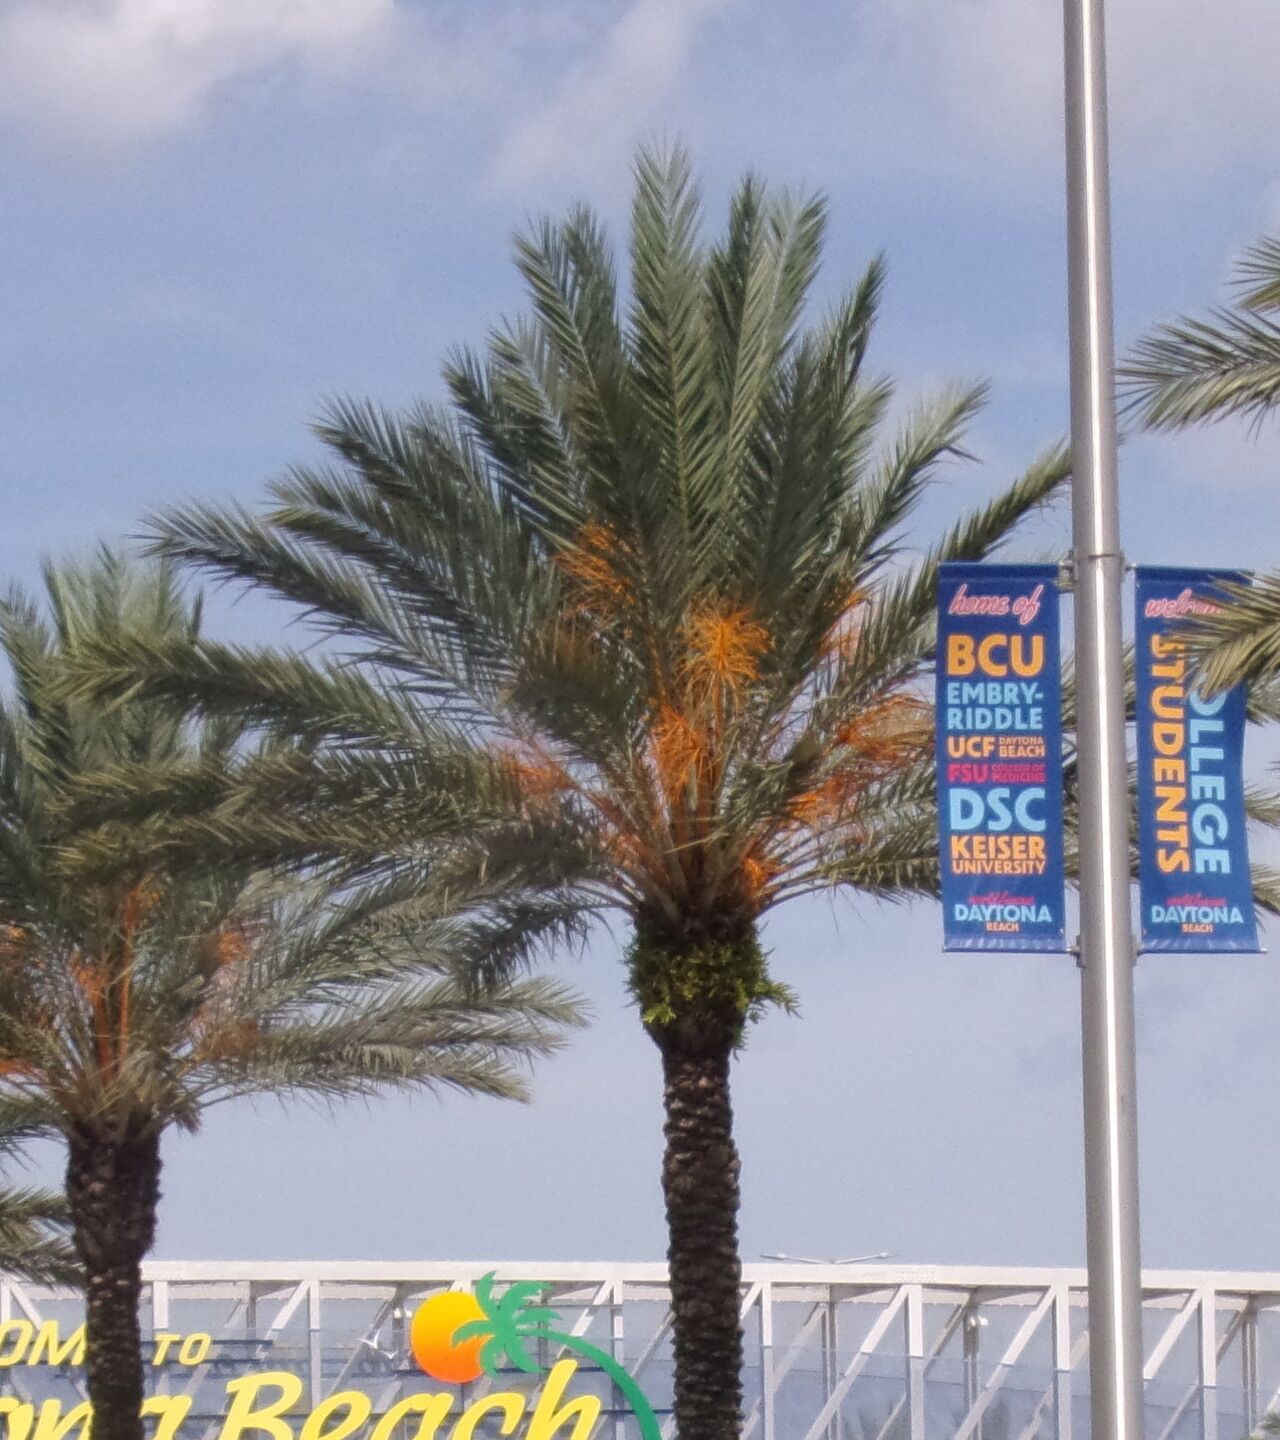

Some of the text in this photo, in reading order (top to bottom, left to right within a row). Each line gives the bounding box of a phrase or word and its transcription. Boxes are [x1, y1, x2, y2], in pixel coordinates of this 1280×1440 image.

[948, 583, 1044, 626] home of
[946, 633, 1045, 678] BCU
[947, 682, 1045, 705] EMBRY-
[947, 707, 1044, 731] RIDDLE
[947, 736, 996, 758] UCF
[998, 736, 1044, 745] DAYTONA
[999, 745, 1046, 758] BEACH
[1151, 632, 1191, 874] STUDENTS
[947, 764, 988, 783] FSU
[949, 787, 1047, 832] DSC
[951, 835, 1046, 859] KEISER
[952, 859, 1046, 875] UNIVERSITY
[954, 904, 1053, 923] DAYTONA
[1151, 905, 1245, 924] DAYTONA
[985, 922, 1020, 932] BEACH
[1182, 923, 1213, 933] BEACH
[151, 1333, 211, 1366] TO
